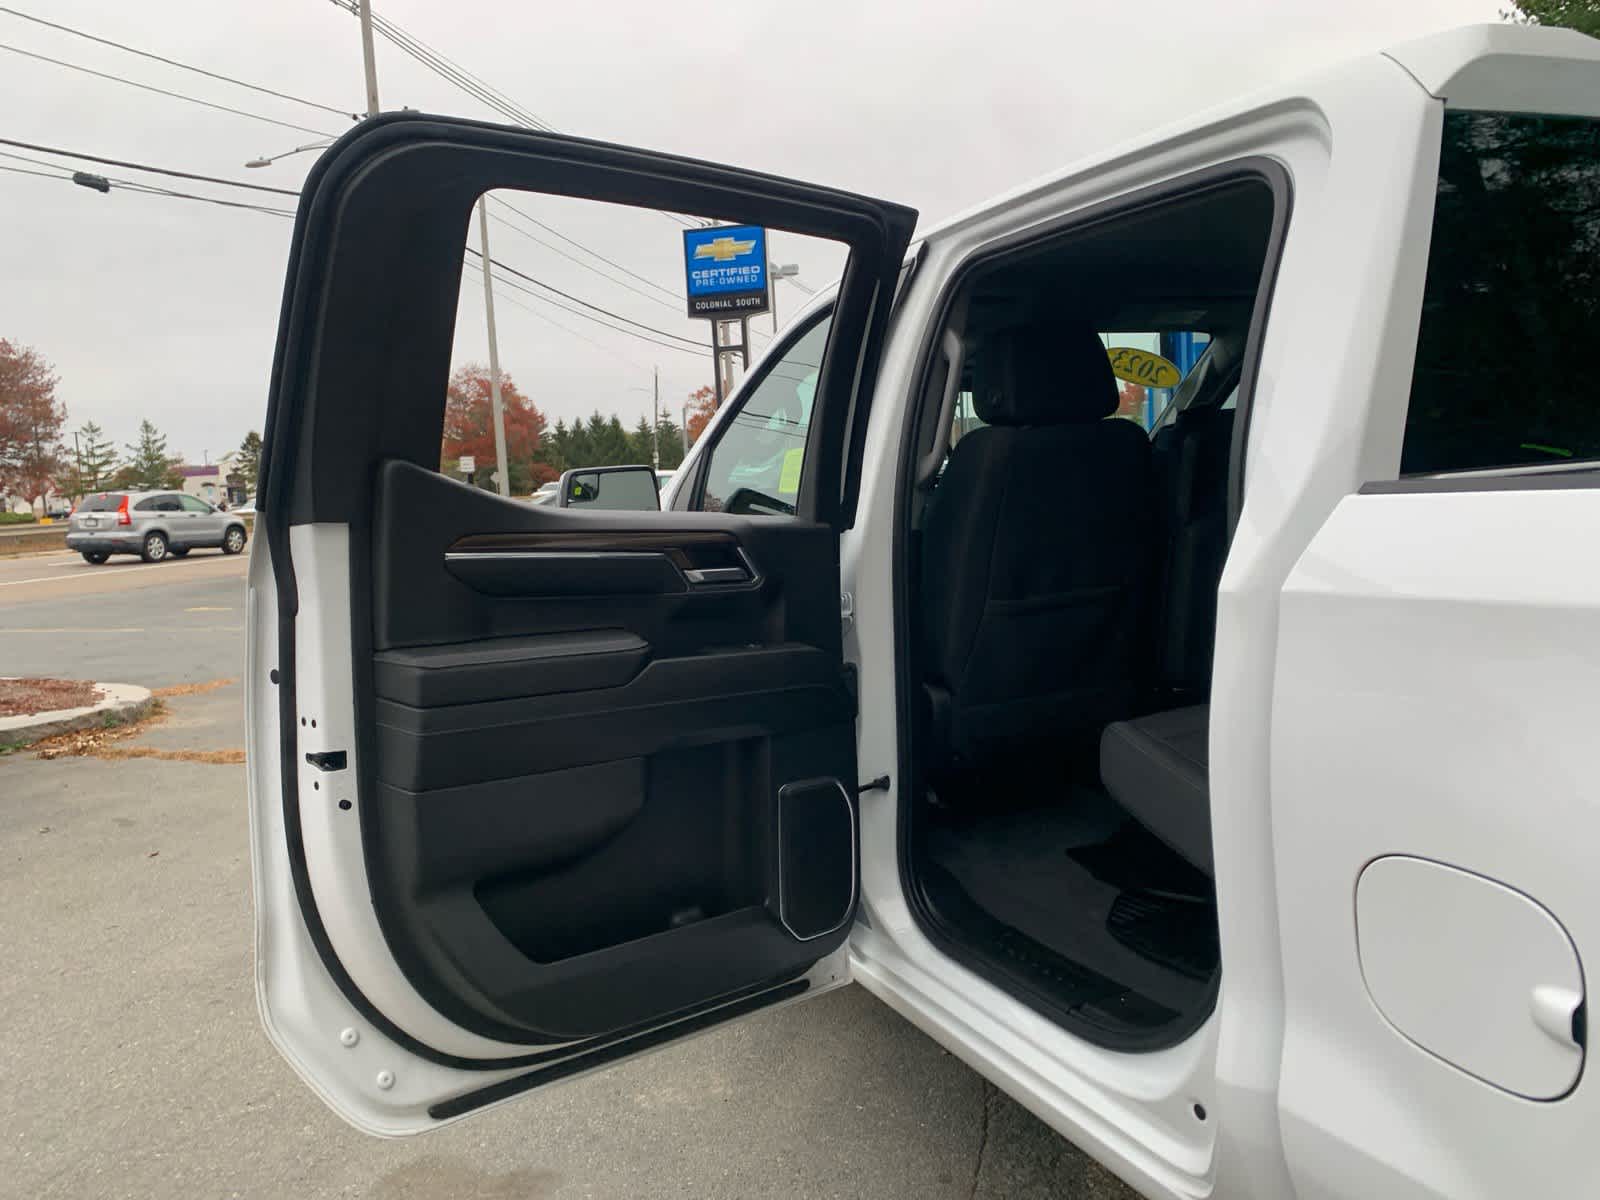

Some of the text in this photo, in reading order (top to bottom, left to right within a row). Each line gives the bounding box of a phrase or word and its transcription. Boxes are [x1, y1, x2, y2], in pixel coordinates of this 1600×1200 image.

[692, 265, 761, 279] CERTIFIED
[695, 275, 758, 287] PRE-OWNED
[695, 297, 761, 310] COLONIAL SOUTH
